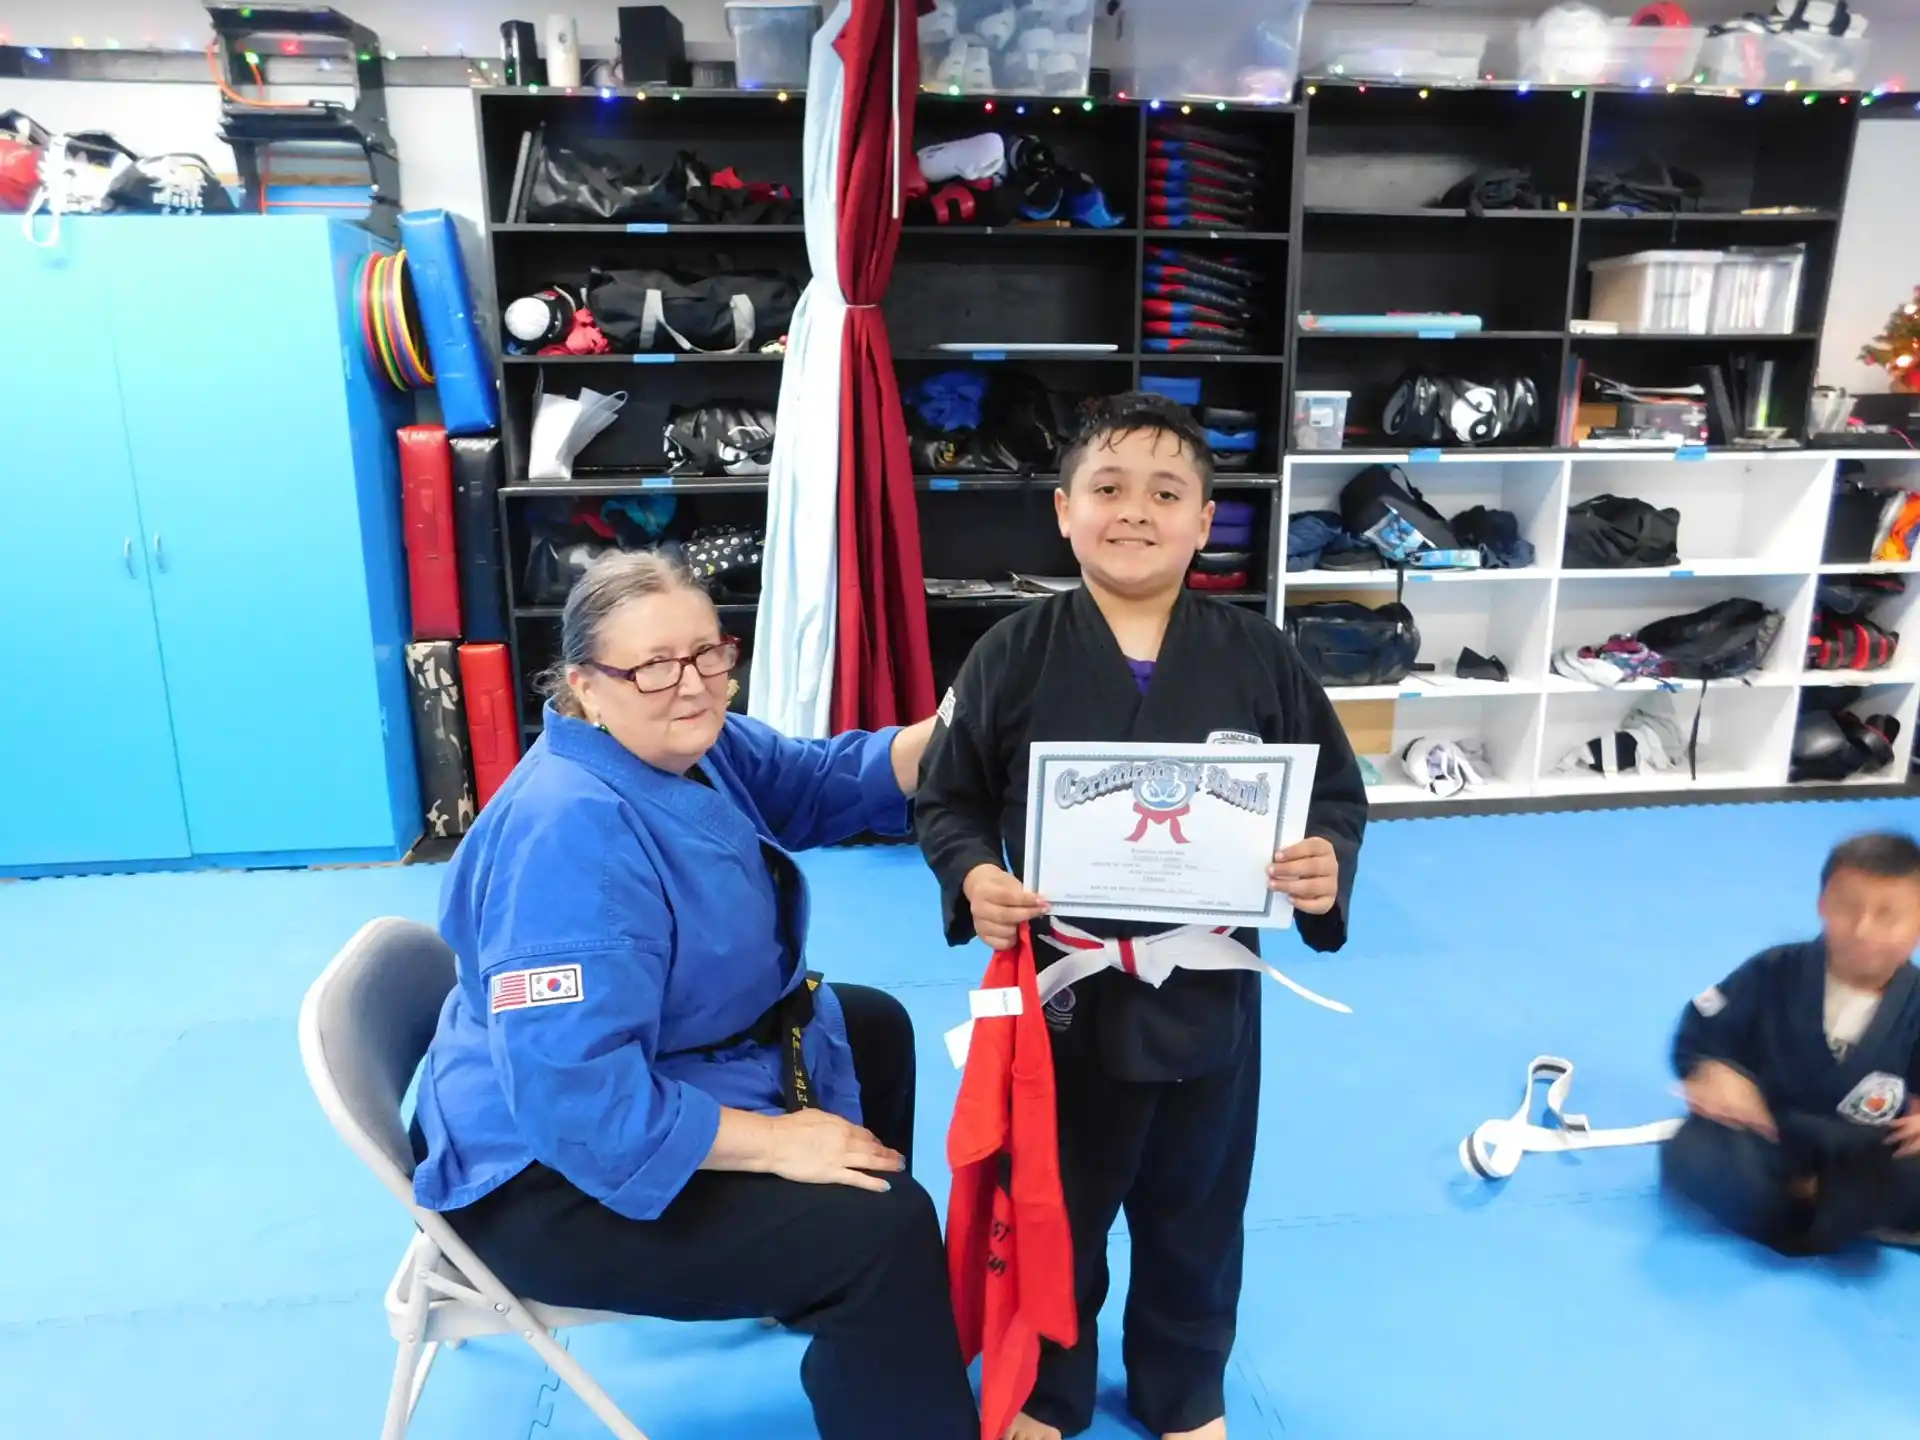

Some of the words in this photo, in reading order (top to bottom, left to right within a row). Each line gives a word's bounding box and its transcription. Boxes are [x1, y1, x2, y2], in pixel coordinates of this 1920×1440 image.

[1221, 732, 1245, 741] TAMPA
[1178, 763, 1203, 788] of
[1206, 765, 1270, 815] Rank
